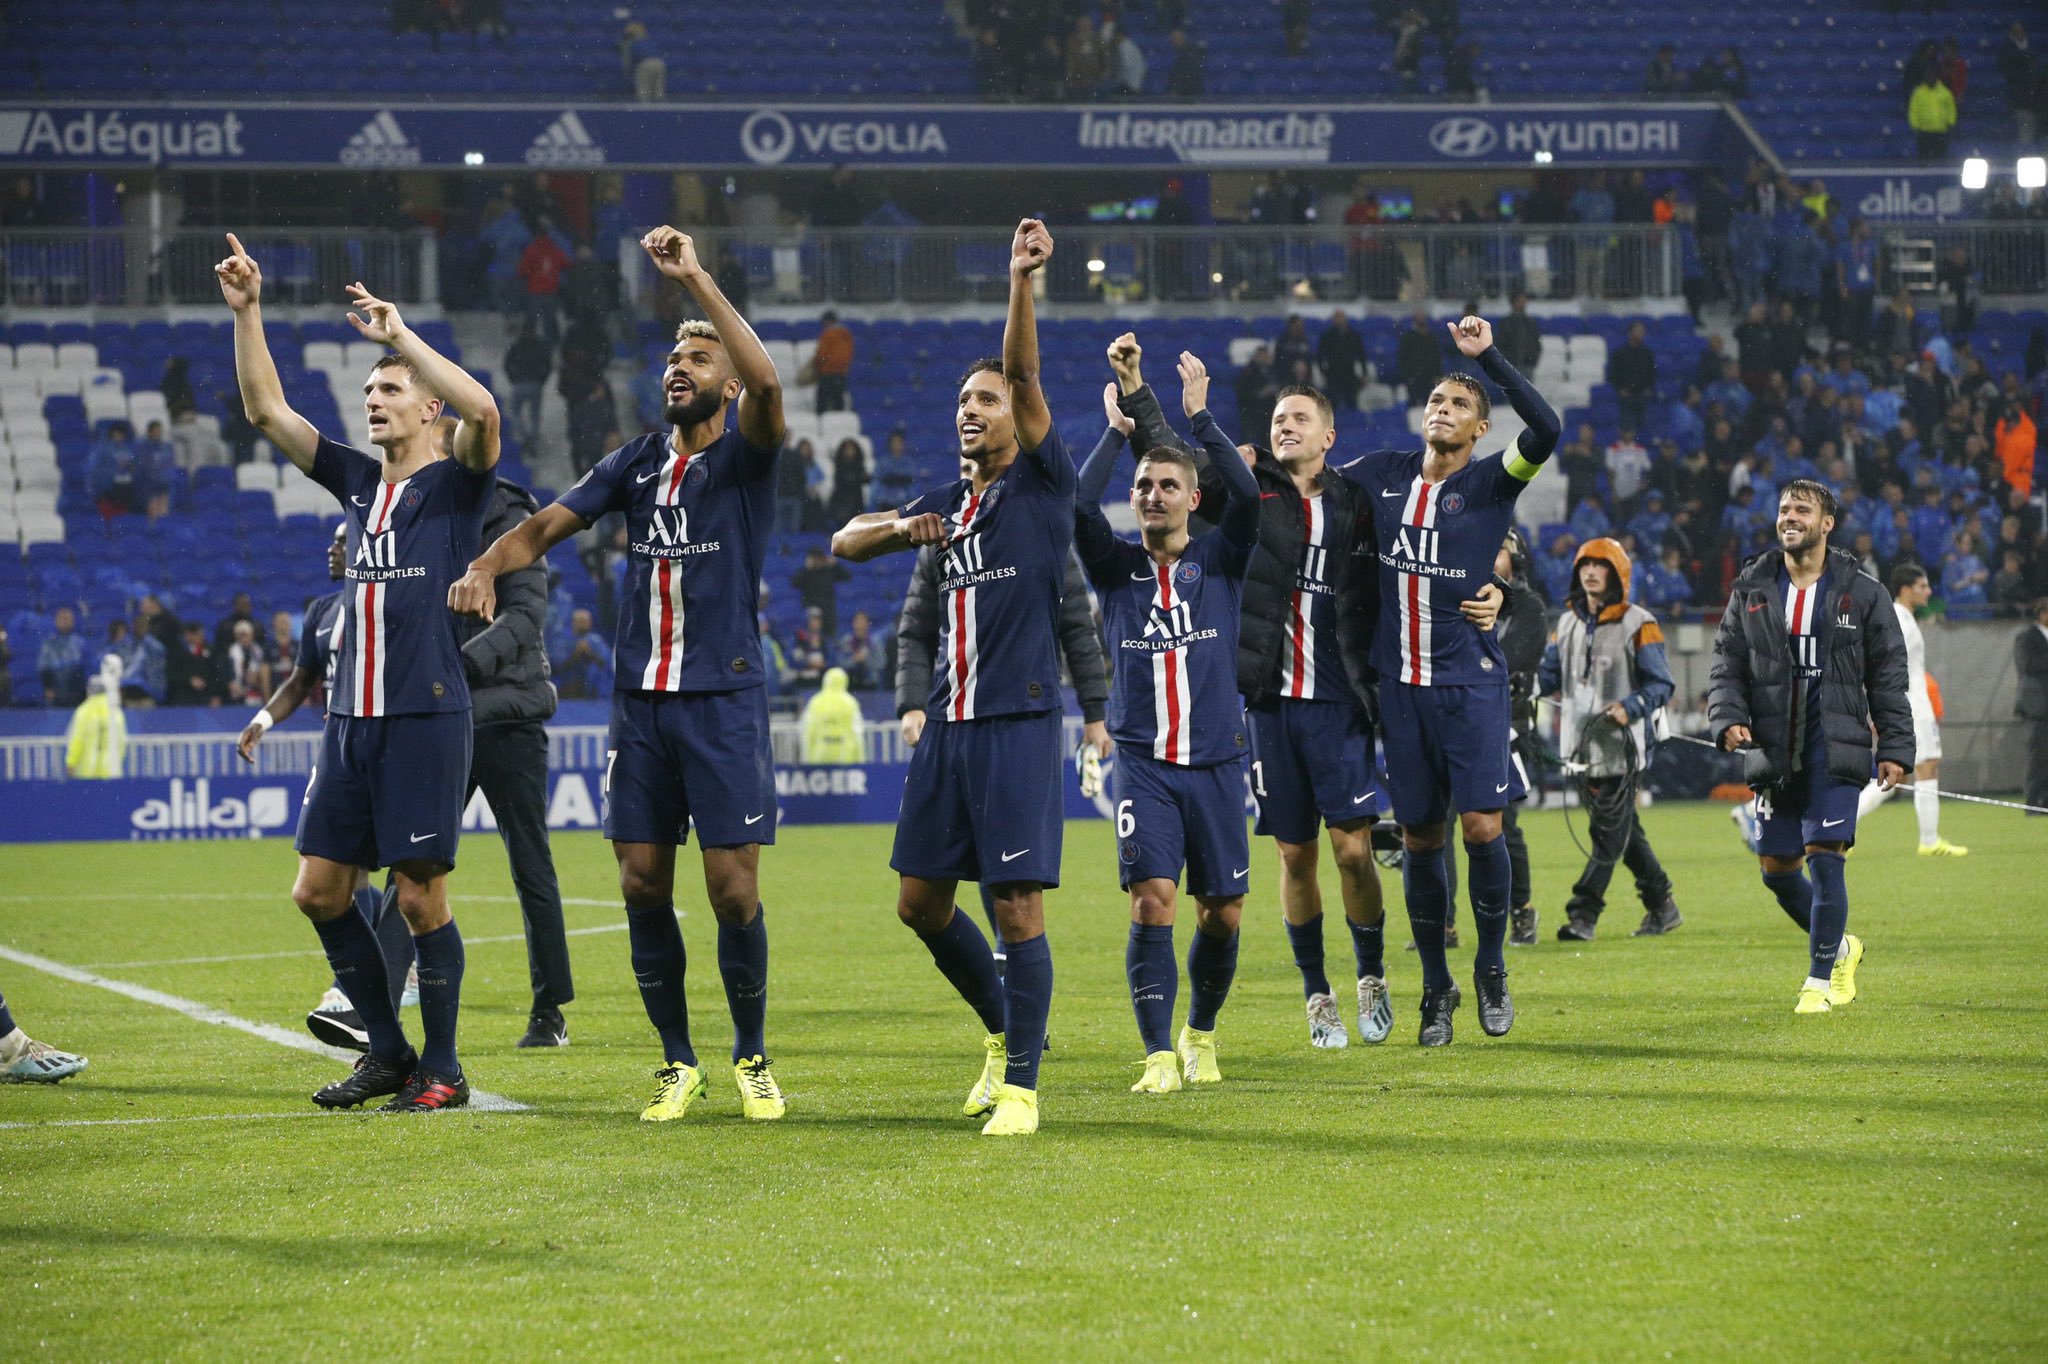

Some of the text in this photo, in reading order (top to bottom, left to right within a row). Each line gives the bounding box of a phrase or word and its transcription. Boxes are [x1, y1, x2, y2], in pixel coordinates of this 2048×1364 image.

[24, 110, 244, 164] Adéquat
[801, 122, 947, 154] VEOLIA
[1505, 121, 1681, 150] HYUNDAI
[1859, 179, 1935, 215] alila
[650, 546, 671, 556] LIVE
[670, 541, 720, 557] LIMITLESS
[359, 570, 376, 579] LIVE
[377, 567, 426, 579] LIMITLESS
[949, 576, 965, 588] LIVE
[966, 566, 1017, 584] LIMITLESS
[1397, 560, 1417, 572] LIVE
[1418, 565, 1467, 578] LIMITLESS
[1121, 628, 1218, 650] ACCOR LIVE LIMITLESS
[131, 777, 248, 830] alila
[1117, 799, 1136, 838] 6
